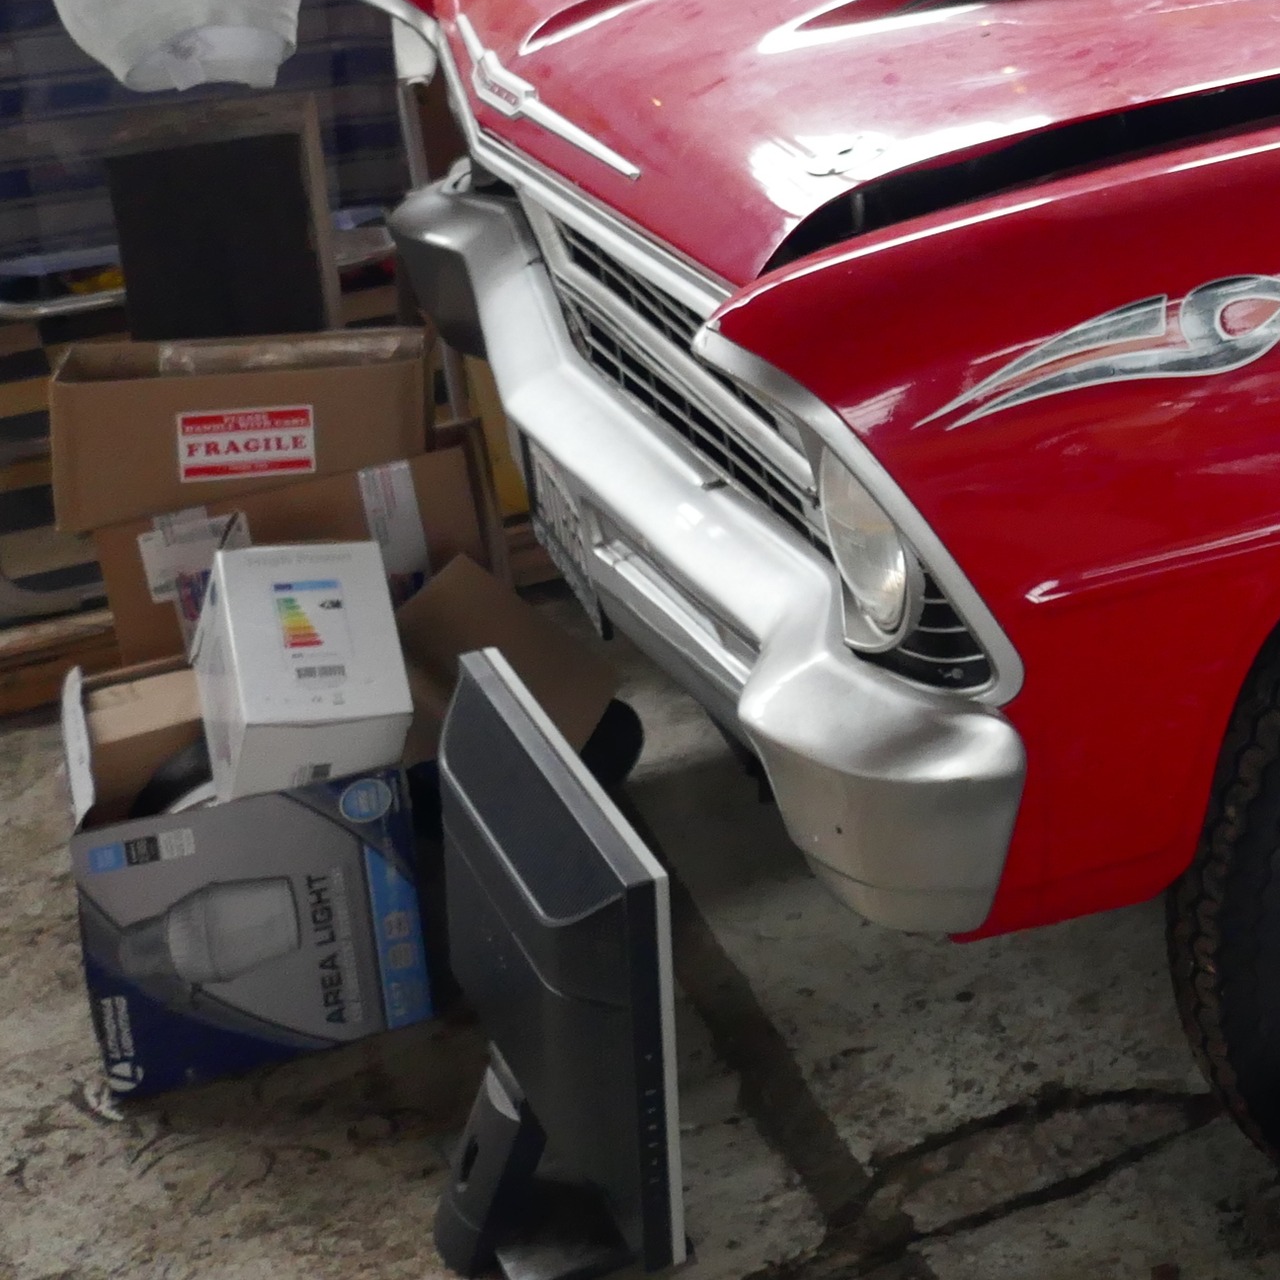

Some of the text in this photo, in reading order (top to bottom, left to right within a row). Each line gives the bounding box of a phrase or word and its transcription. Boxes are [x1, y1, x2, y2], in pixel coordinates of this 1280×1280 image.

[186, 434, 307, 458] FRAGILE
[305, 873, 348, 1025] AREA LIGHT
